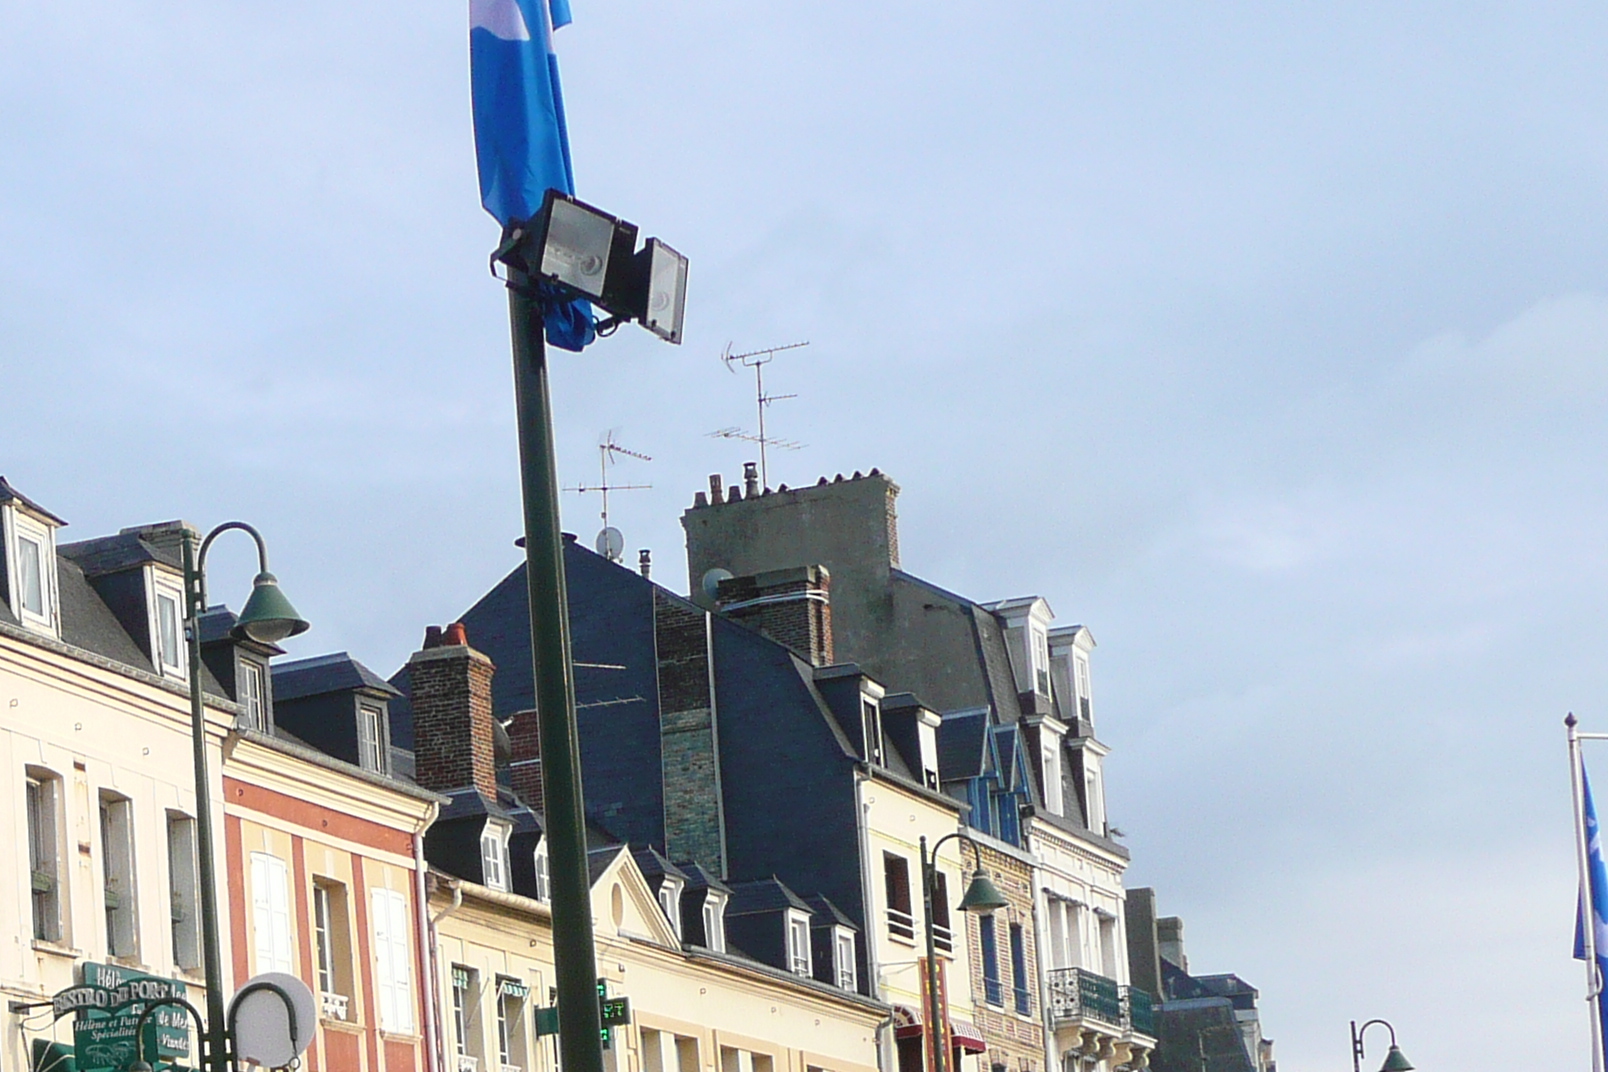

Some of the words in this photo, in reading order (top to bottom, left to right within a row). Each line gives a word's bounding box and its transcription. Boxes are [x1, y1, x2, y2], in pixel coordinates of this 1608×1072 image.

[129, 979, 169, 1000] PORT
[75, 1018, 106, 1032] Hélène
[108, 1019, 118, 1028] et
